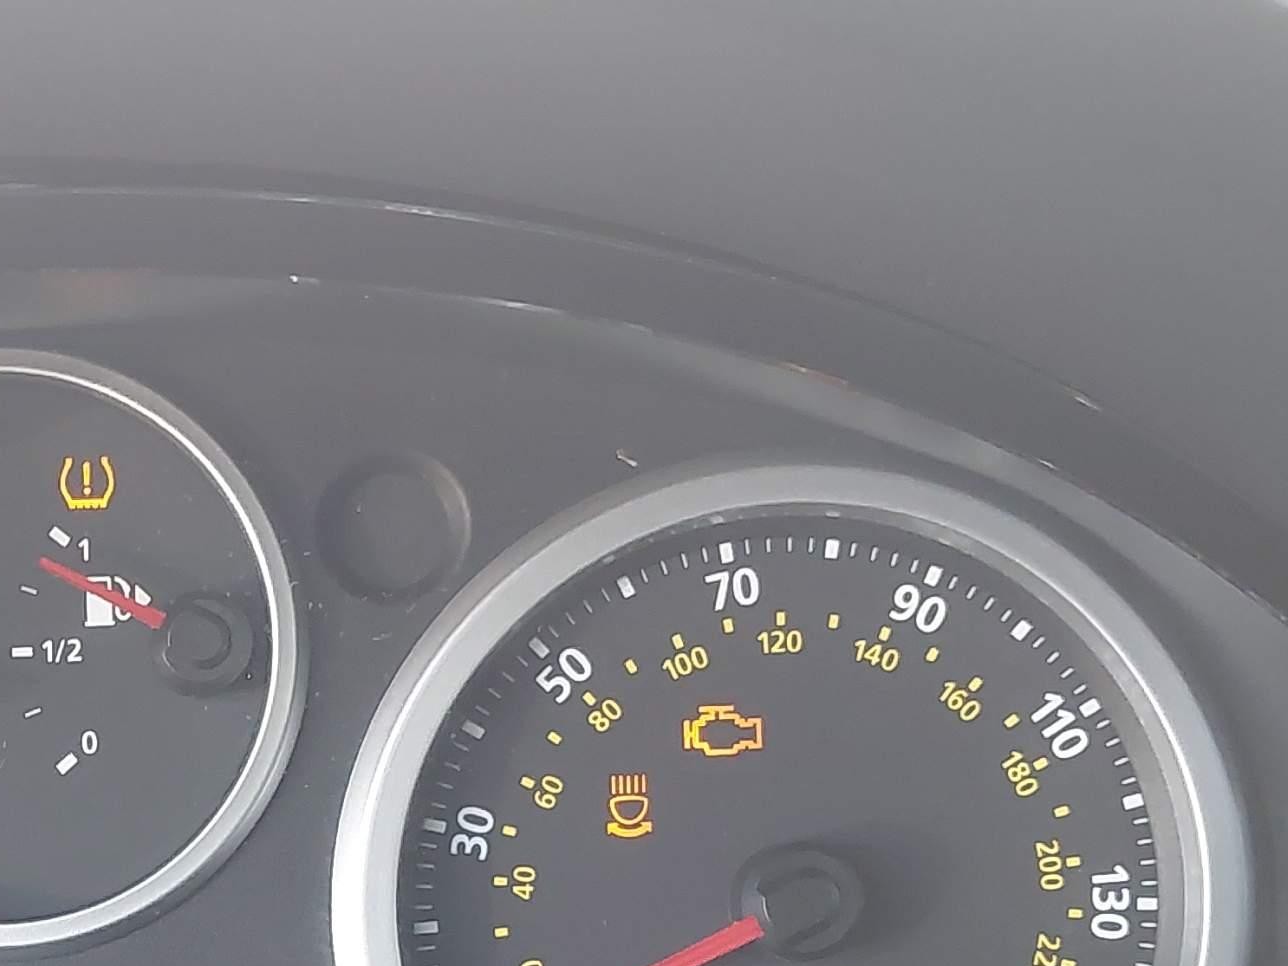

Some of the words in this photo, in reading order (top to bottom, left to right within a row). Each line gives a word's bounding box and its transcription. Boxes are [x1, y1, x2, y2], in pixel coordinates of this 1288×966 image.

[78, 538, 89, 562] 1
[704, 567, 760, 611] 70
[888, 583, 947, 635] 90
[42, 638, 83, 663] 1/2
[757, 630, 803, 654] 120
[854, 639, 899, 671] 140
[536, 647, 592, 704] 50
[662, 646, 708, 680] 100
[587, 699, 622, 732] 80
[939, 680, 982, 721] 160
[81, 730, 98, 755] 0
[1031, 692, 1089, 760] 110
[533, 775, 564, 809] 60
[1002, 751, 1039, 796] 180
[450, 806, 494, 861] 30
[512, 866, 536, 900] 40
[1035, 839, 1064, 890] 200
[1090, 864, 1131, 940] 130
